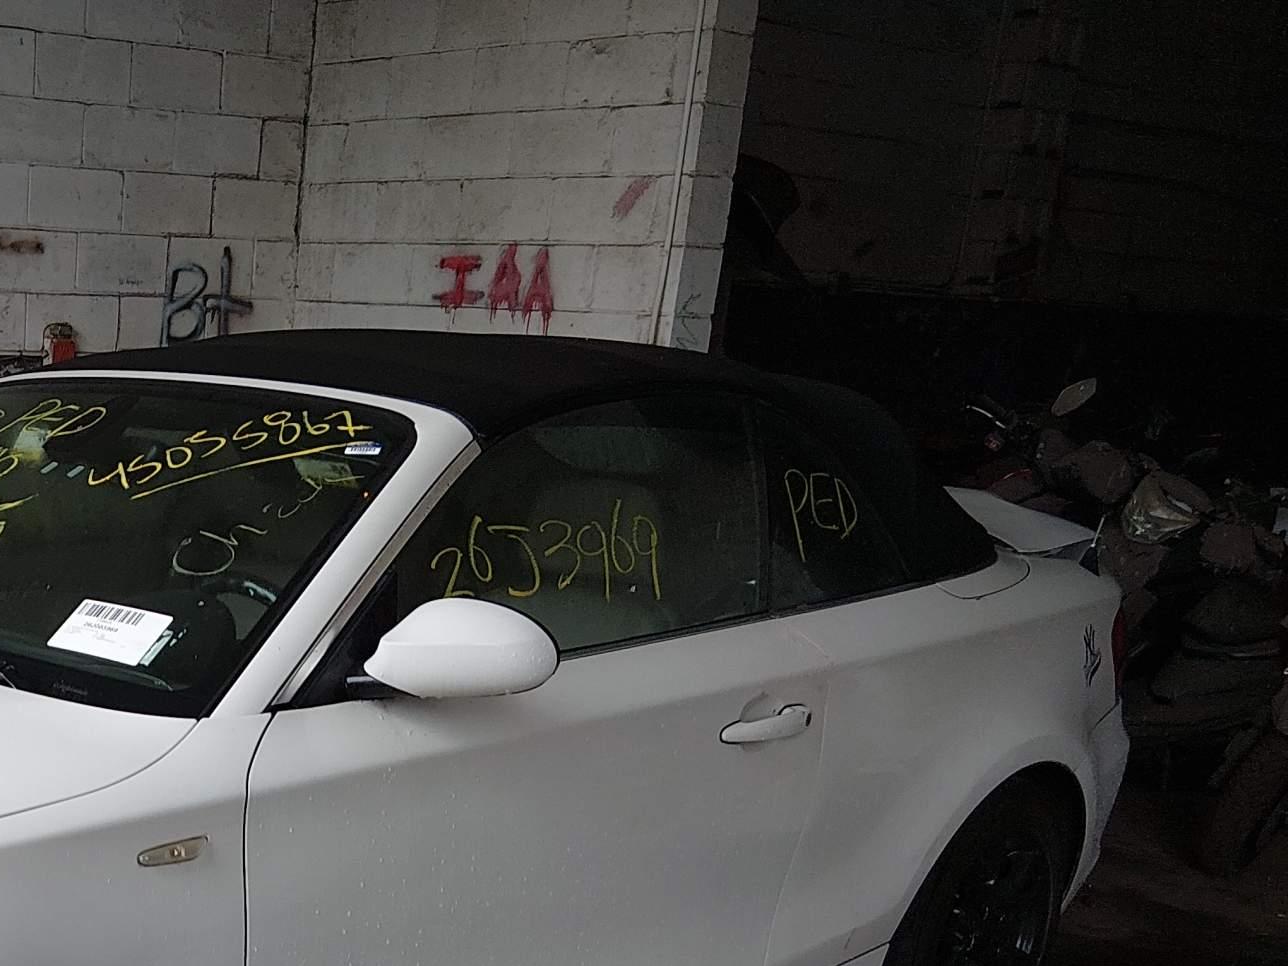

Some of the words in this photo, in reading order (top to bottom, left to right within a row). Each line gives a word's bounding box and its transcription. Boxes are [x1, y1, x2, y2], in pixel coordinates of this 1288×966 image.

[432, 241, 554, 326] IAA
[87, 410, 373, 491] 45055867
[783, 468, 859, 562] PED
